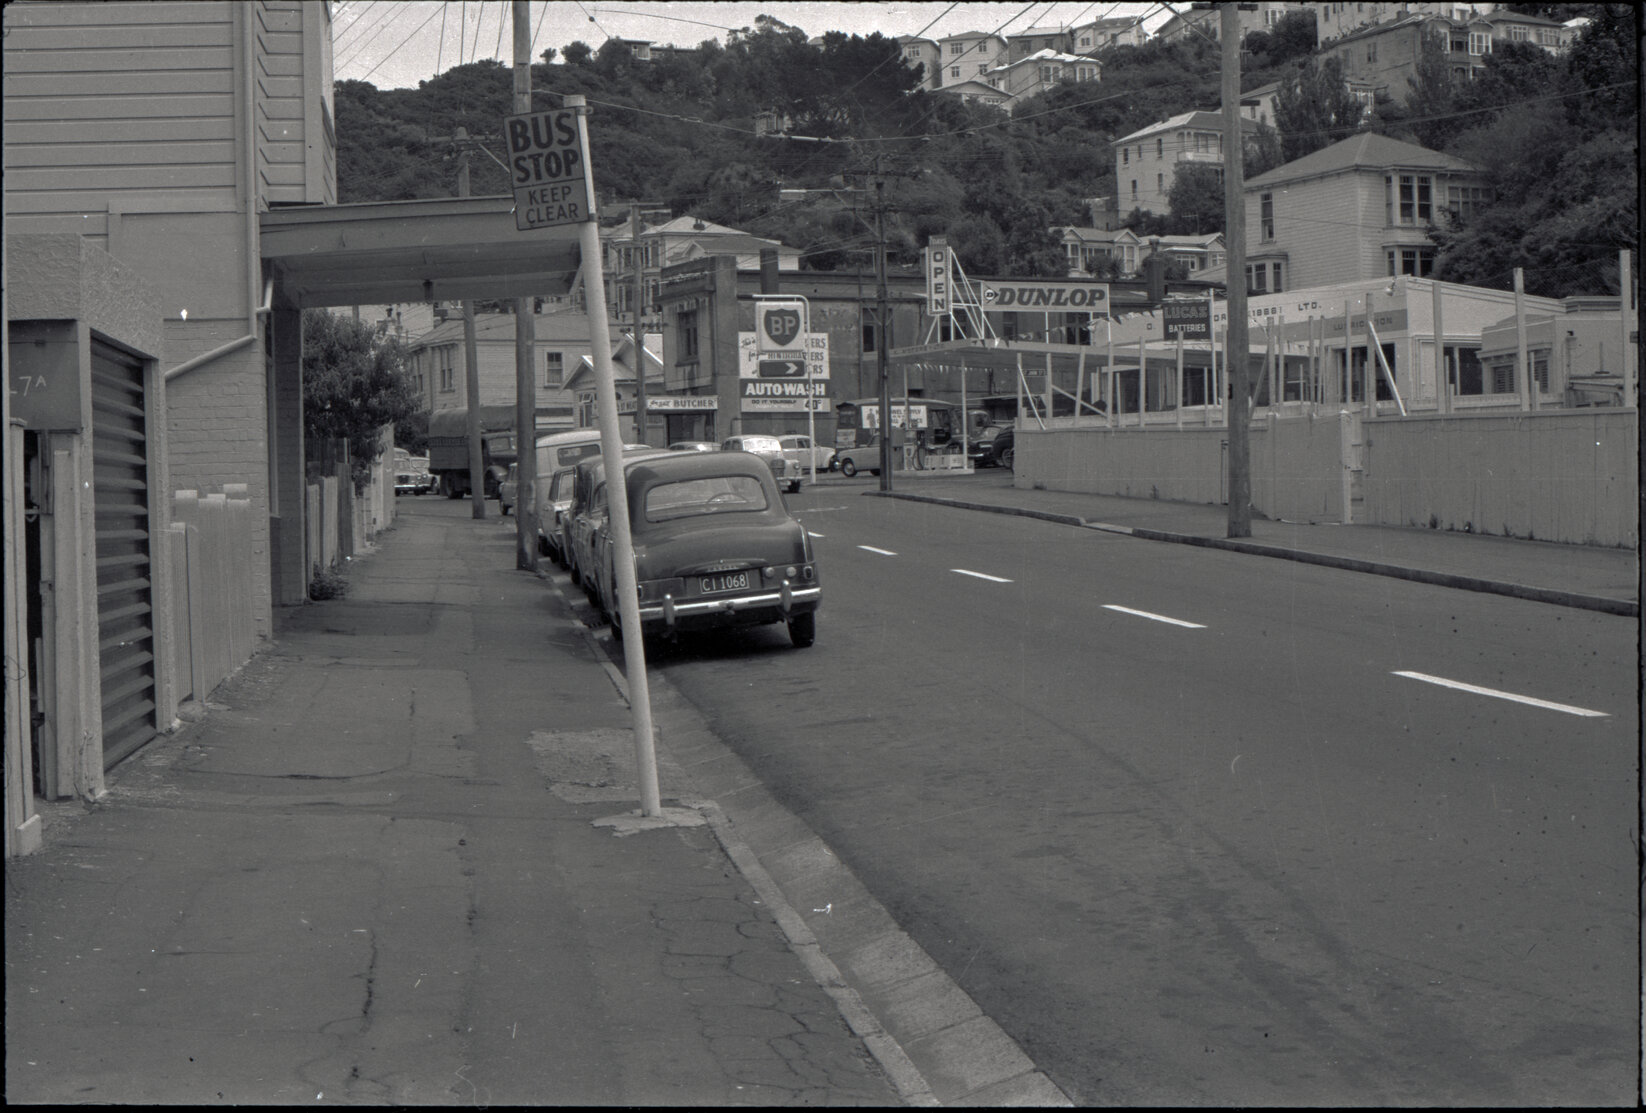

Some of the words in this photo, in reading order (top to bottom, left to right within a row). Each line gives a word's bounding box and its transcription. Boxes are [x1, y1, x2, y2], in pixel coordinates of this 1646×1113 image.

[508, 112, 576, 153] BUS
[513, 149, 579, 183] STOP
[528, 185, 572, 206] KEEP
[526, 202, 579, 224] CLEAR
[933, 251, 945, 310] OPEN
[995, 287, 1106, 307] DUNLOP
[1164, 306, 1208, 319] LUCAS
[770, 315, 796, 336] BP
[1168, 323, 1206, 333] BATTERIES
[673, 399, 714, 408] BUTCHER
[720, 574, 746, 589] 1068
